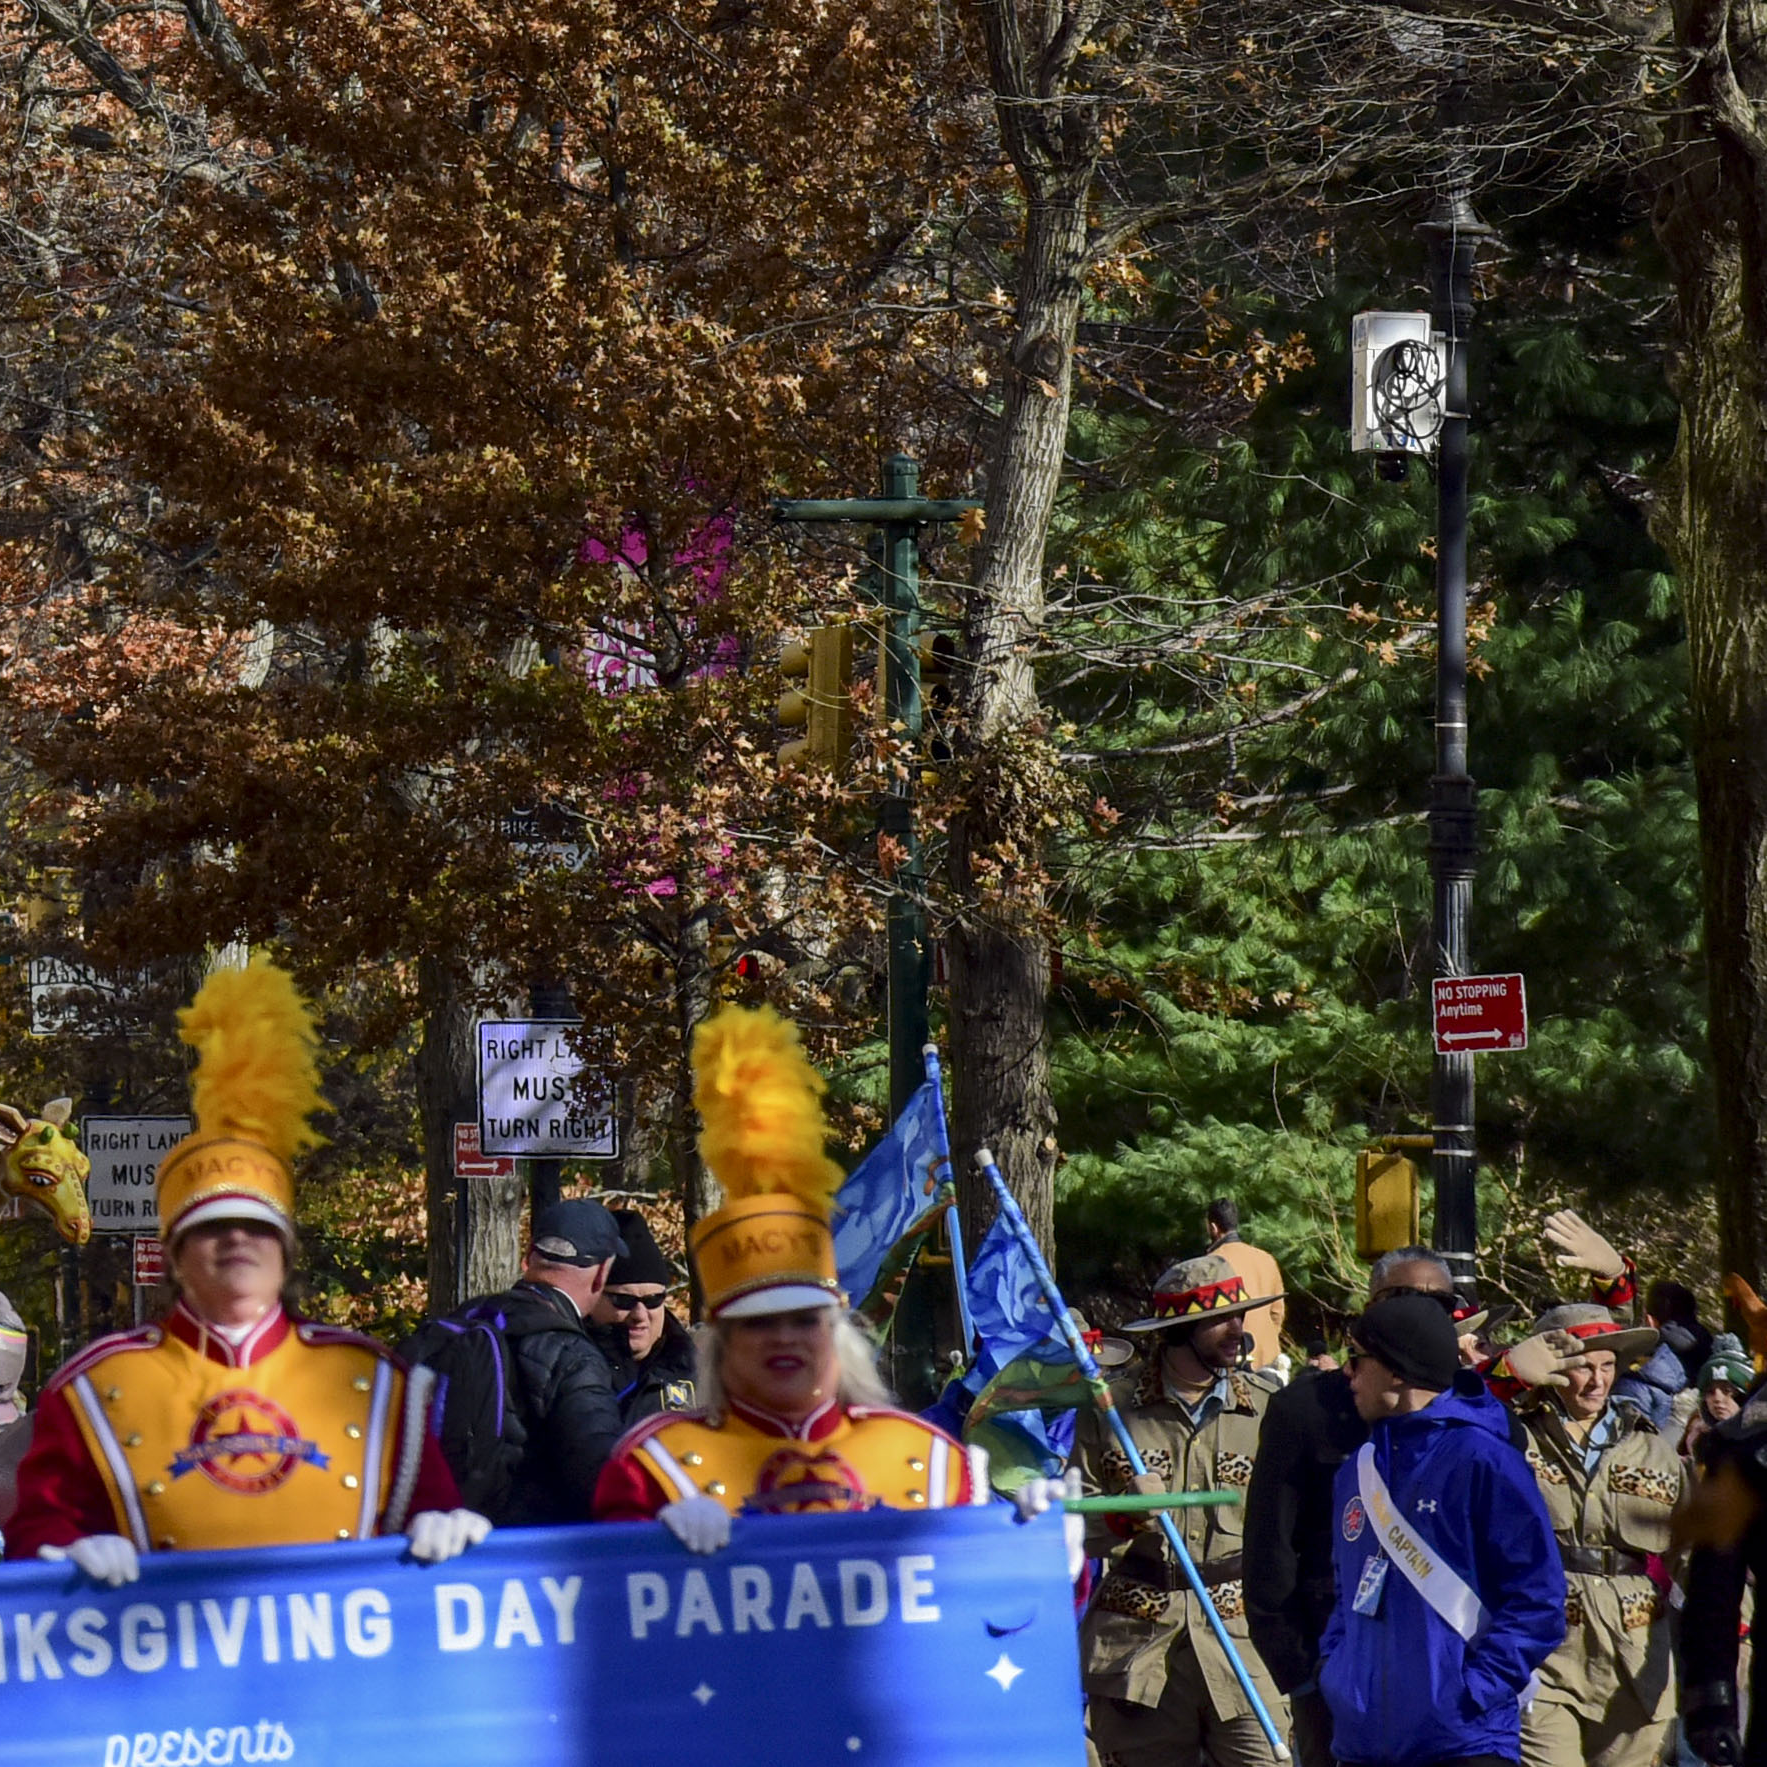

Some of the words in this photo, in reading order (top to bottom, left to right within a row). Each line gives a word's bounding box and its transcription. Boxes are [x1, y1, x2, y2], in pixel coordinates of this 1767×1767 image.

[1437, 986, 1454, 1001] NO
[1455, 983, 1508, 999] STOPPING
[1439, 1003, 1484, 1020] Anytime
[487, 1039, 547, 1060] RIGHT
[512, 1077, 566, 1101] MUS
[487, 1118, 540, 1138] TURN
[549, 1118, 609, 1139] RIGHT
[91, 1133, 139, 1151] RIGHT
[111, 1163, 157, 1186] MUS
[92, 1198, 135, 1217] TURN
[1387, 1525, 1434, 1580] CAPTAIN
[434, 1574, 583, 1652] DAY
[626, 1553, 942, 1640] PARADE
